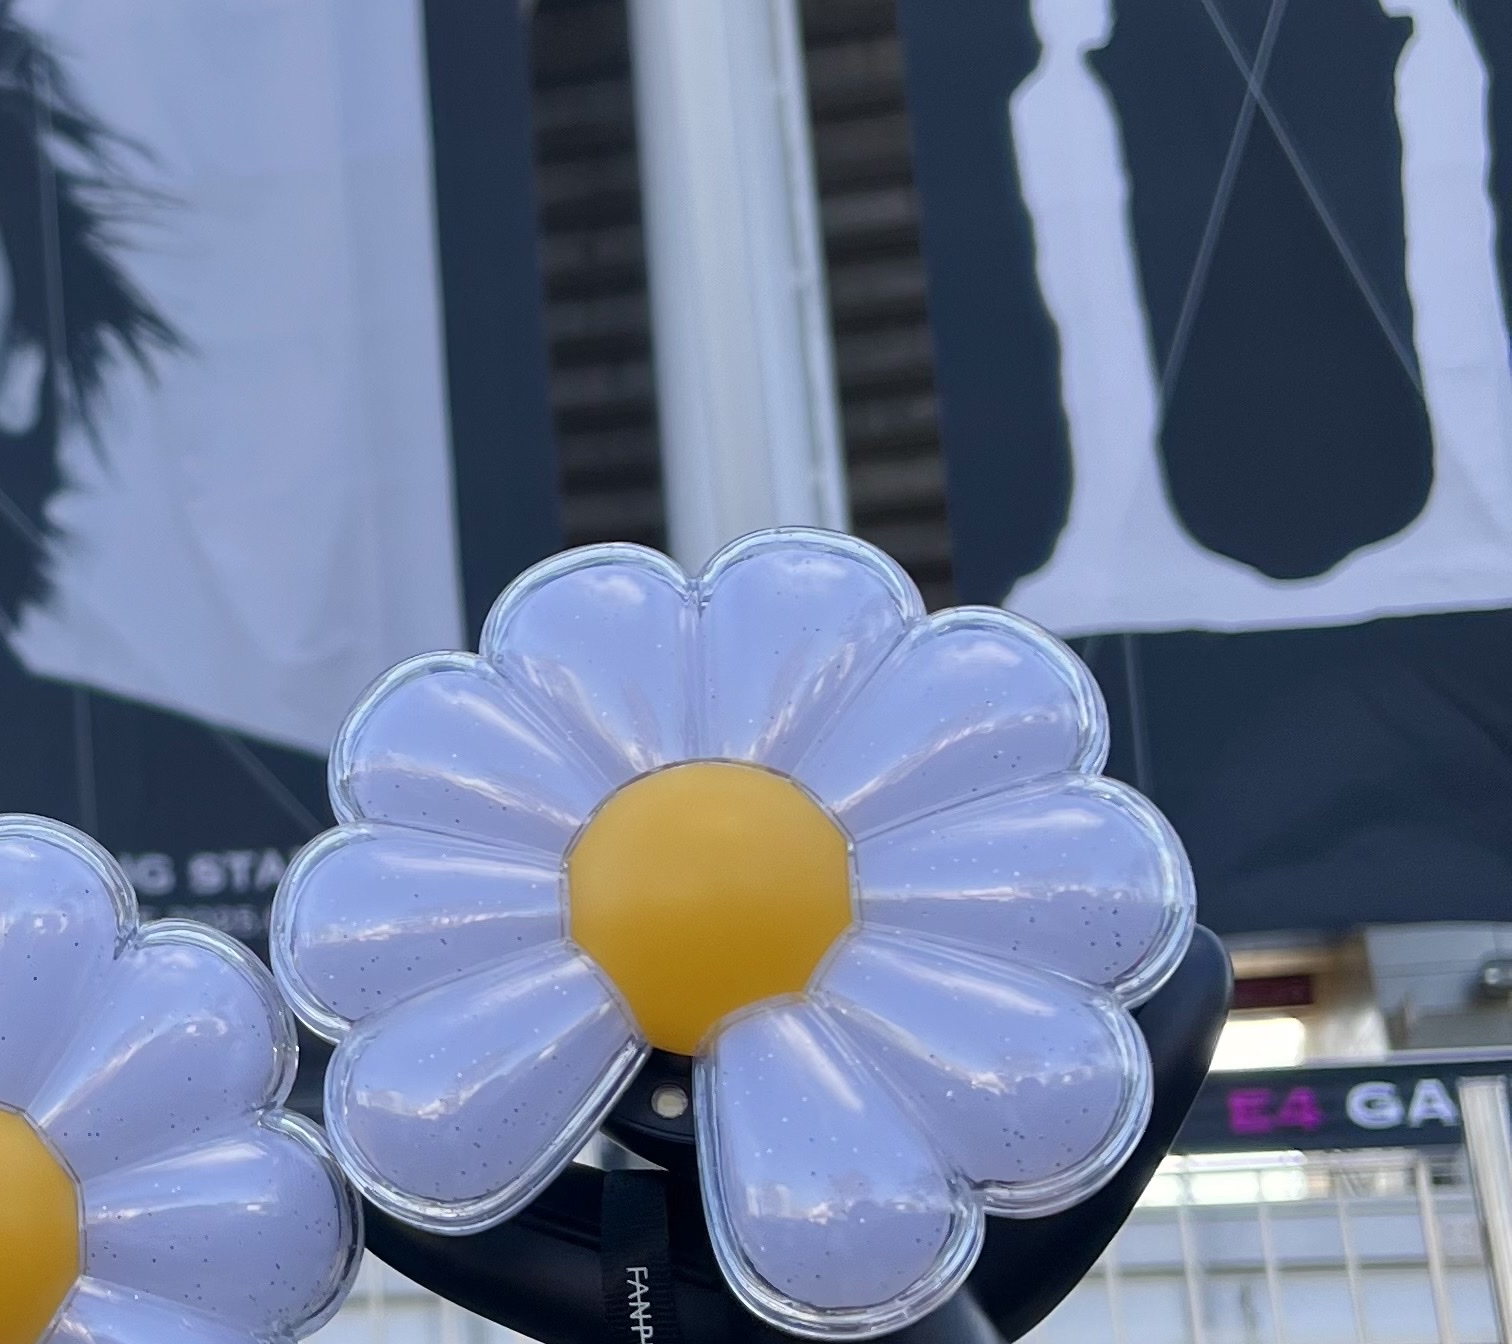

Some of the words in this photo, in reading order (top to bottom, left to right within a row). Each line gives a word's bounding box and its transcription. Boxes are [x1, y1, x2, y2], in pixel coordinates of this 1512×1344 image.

[188, 846, 294, 896] STA
[1227, 1087, 1322, 1134] E4
[1346, 1078, 1458, 1129] GA
